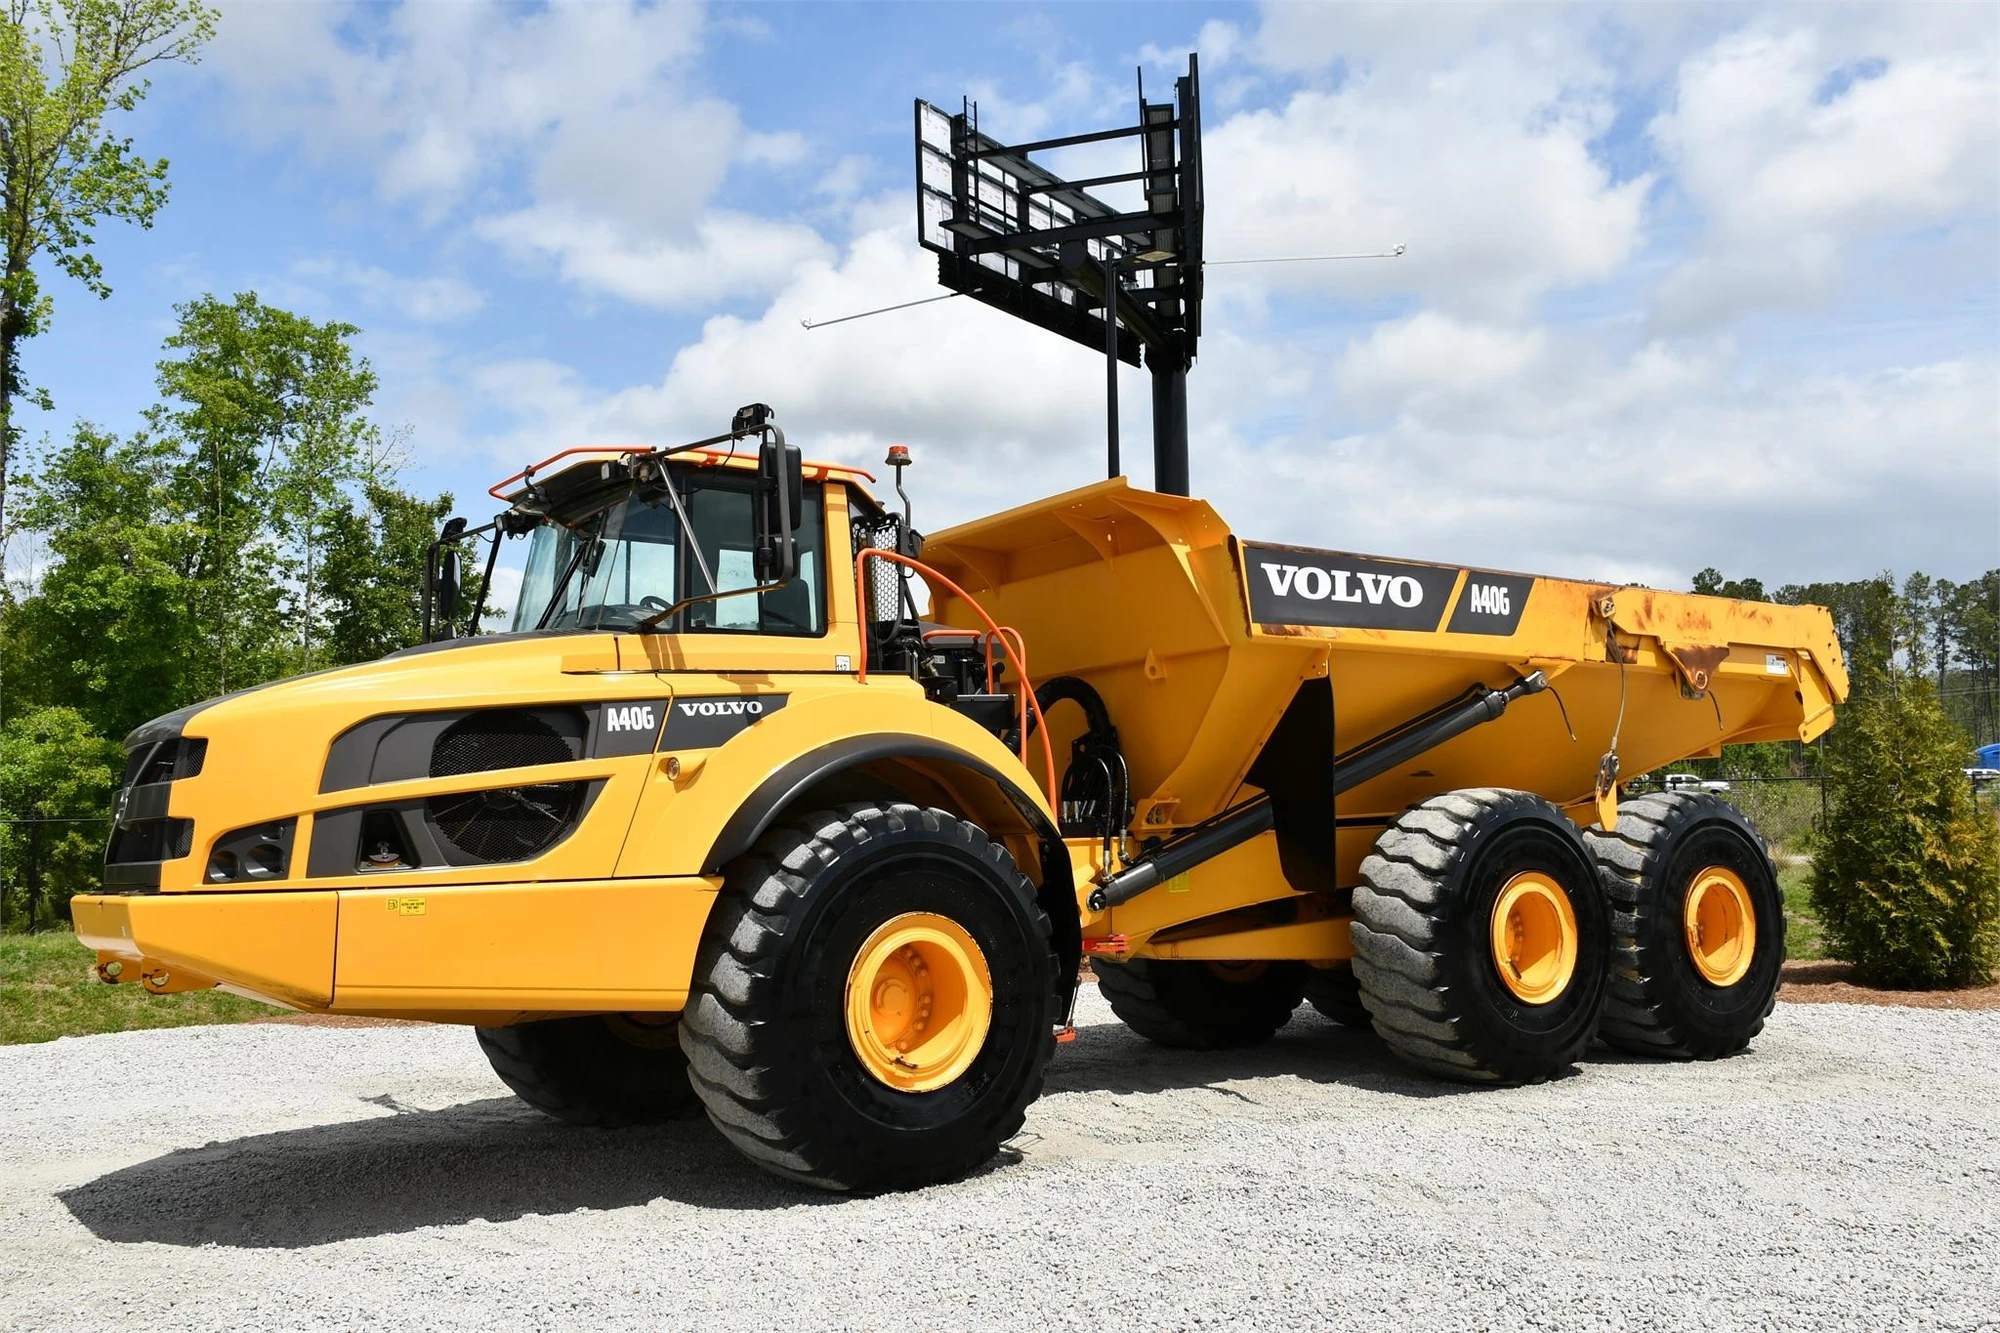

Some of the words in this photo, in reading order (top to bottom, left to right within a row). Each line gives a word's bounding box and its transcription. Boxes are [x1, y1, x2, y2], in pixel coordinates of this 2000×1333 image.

[1261, 563, 1423, 608] VOLVO
[1471, 584, 1510, 615] A40G
[607, 706, 655, 732] A40G
[678, 701, 763, 717] VOLVO
